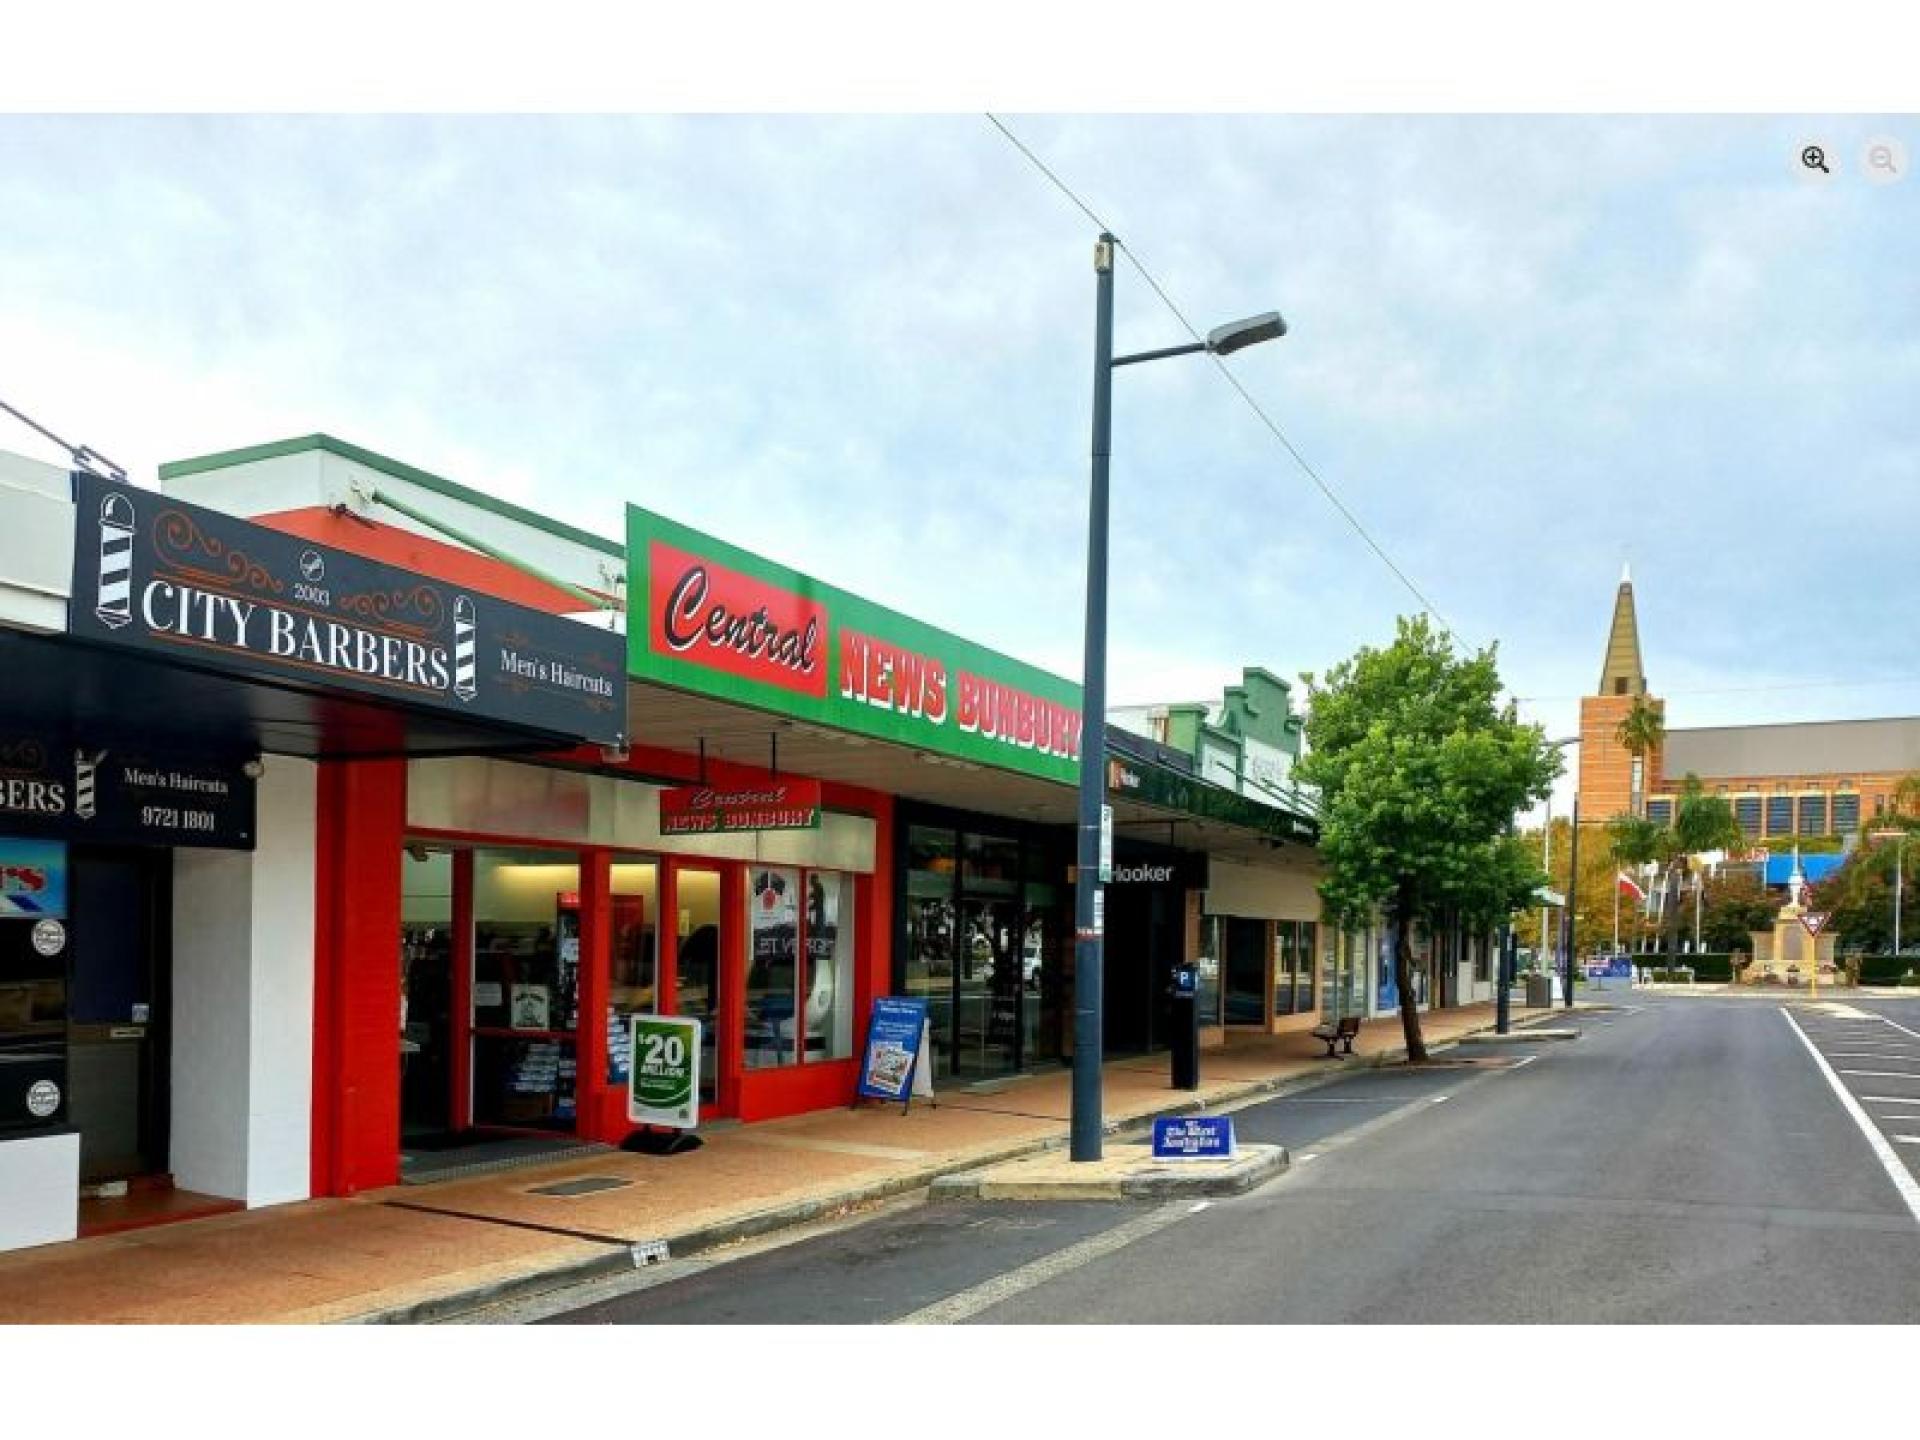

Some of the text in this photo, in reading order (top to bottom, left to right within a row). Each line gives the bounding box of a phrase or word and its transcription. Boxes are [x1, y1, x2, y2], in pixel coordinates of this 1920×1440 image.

[142, 579, 450, 690] CITY BARBERS
[664, 565, 817, 674] Central
[500, 648, 614, 698] Men's Haircuts
[839, 627, 948, 725] NEWS
[124, 767, 229, 794] Men's Haircuts
[142, 805, 215, 832] 9721 1801
